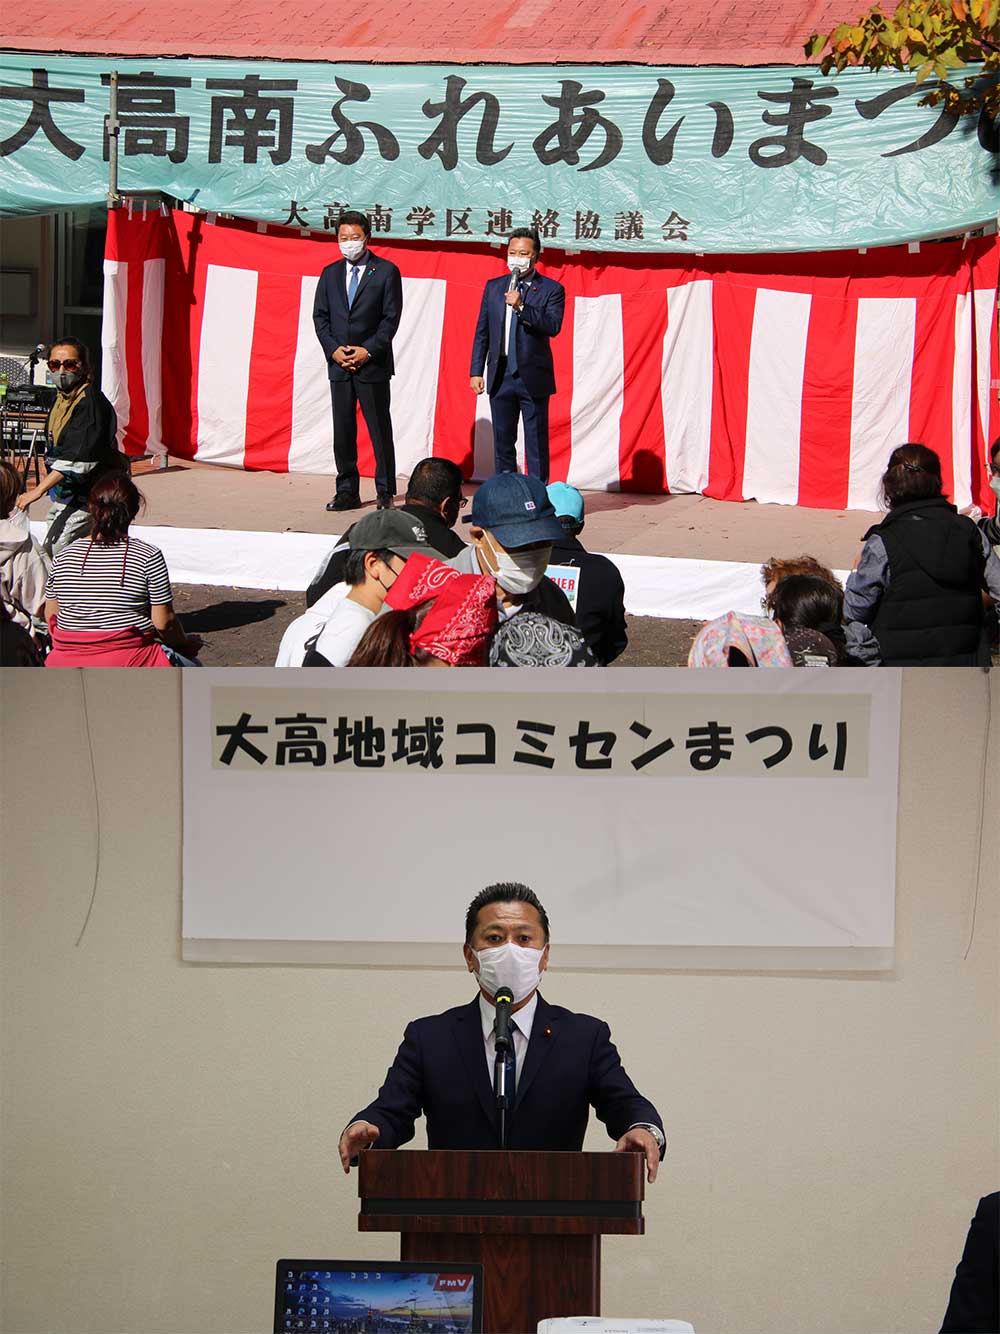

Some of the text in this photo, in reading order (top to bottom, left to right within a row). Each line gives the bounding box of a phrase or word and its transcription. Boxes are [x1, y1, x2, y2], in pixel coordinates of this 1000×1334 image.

[0, 68, 1000, 171] 大高南ふれあいまつ
[281, 200, 691, 242] 大高南学区連絡協議会
[215, 712, 848, 771] 大高地域コミセンまつり
[439, 1279, 467, 1287] FMV
